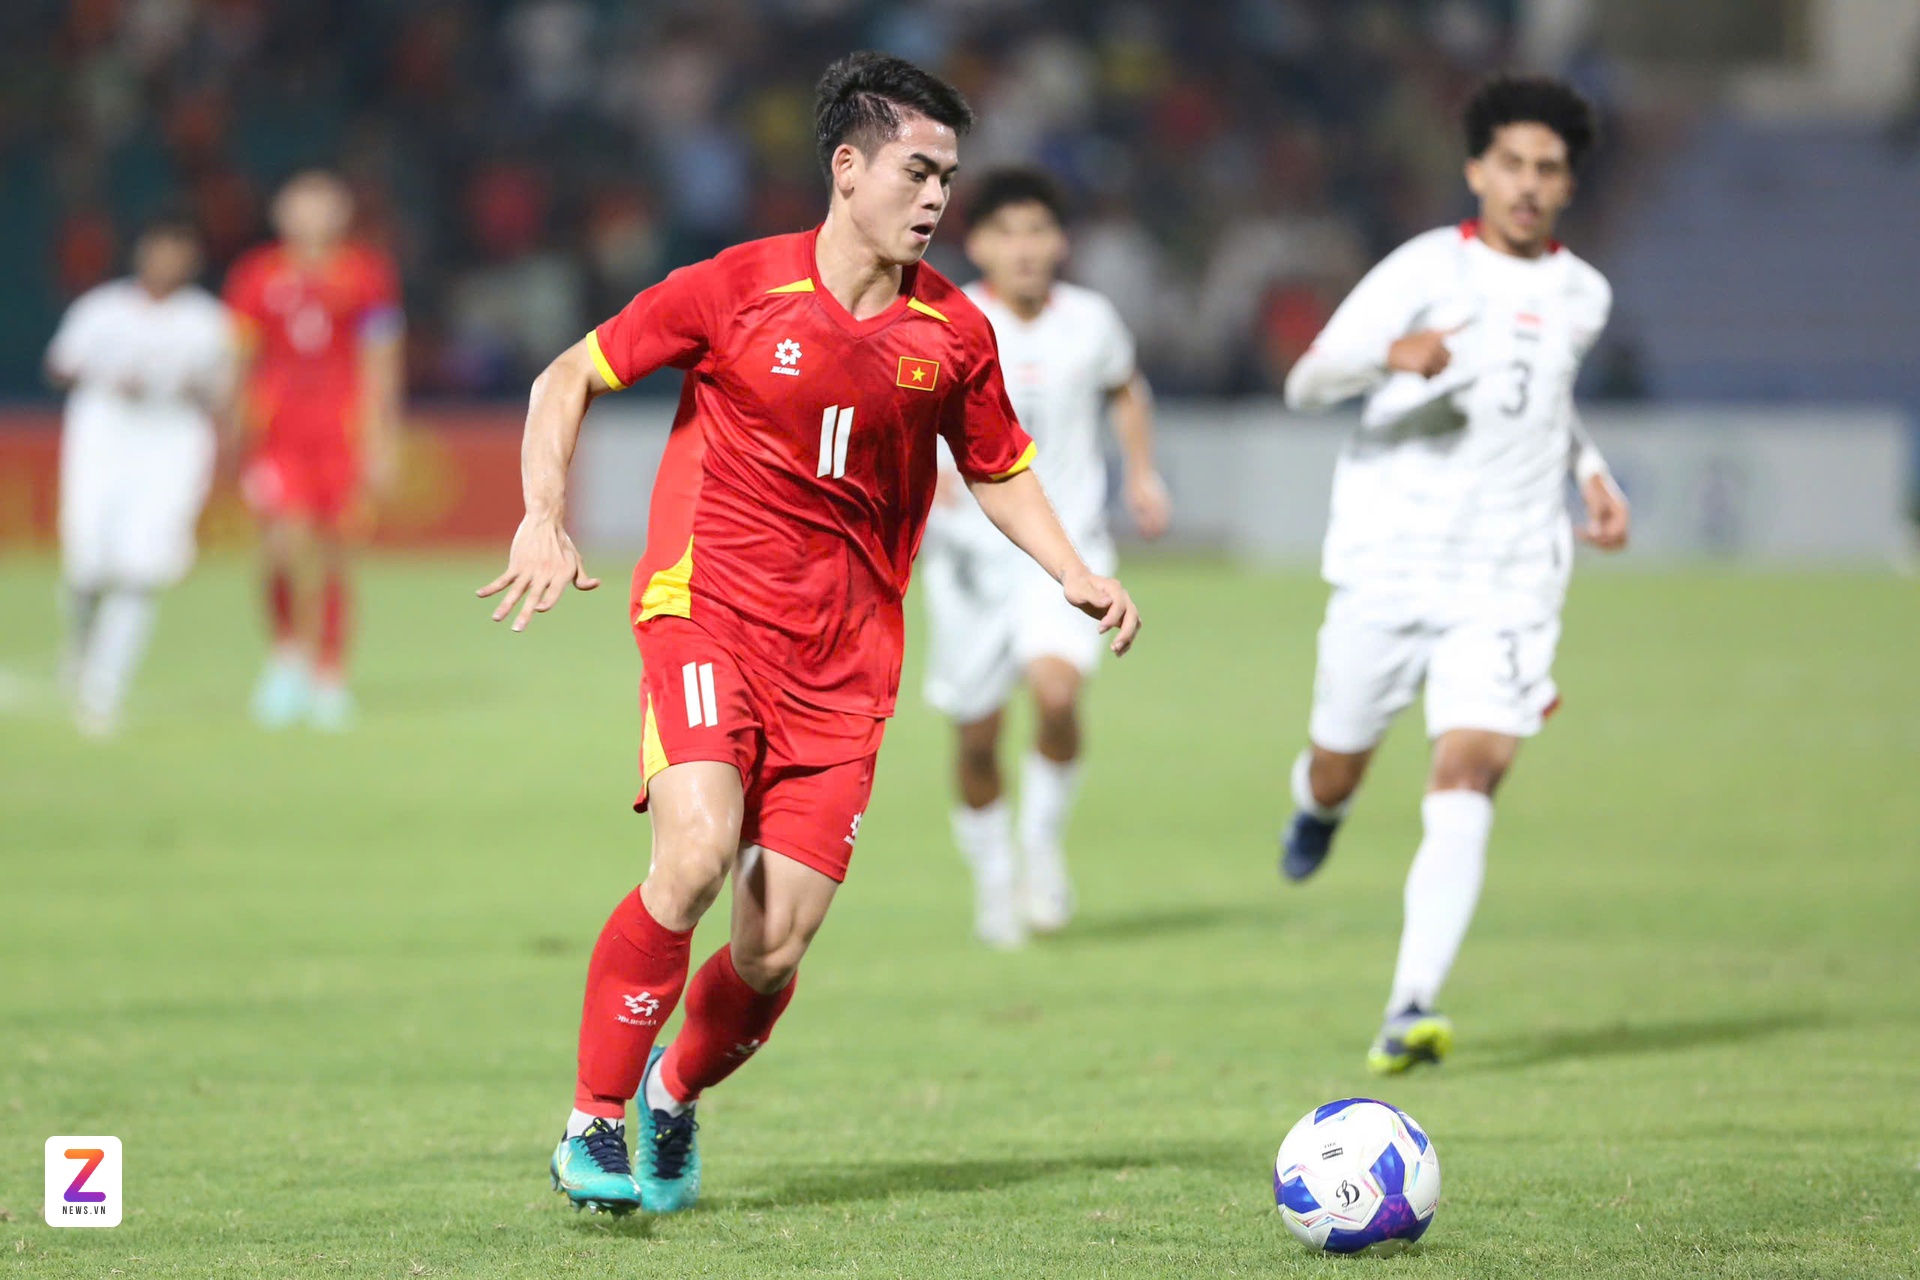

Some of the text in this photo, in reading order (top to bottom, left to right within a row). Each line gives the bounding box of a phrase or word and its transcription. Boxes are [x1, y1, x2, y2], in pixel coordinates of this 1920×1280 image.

[1499, 358, 1533, 418] 3
[816, 404, 855, 479] 11
[1495, 628, 1521, 687] 3
[682, 661, 719, 729] 11
